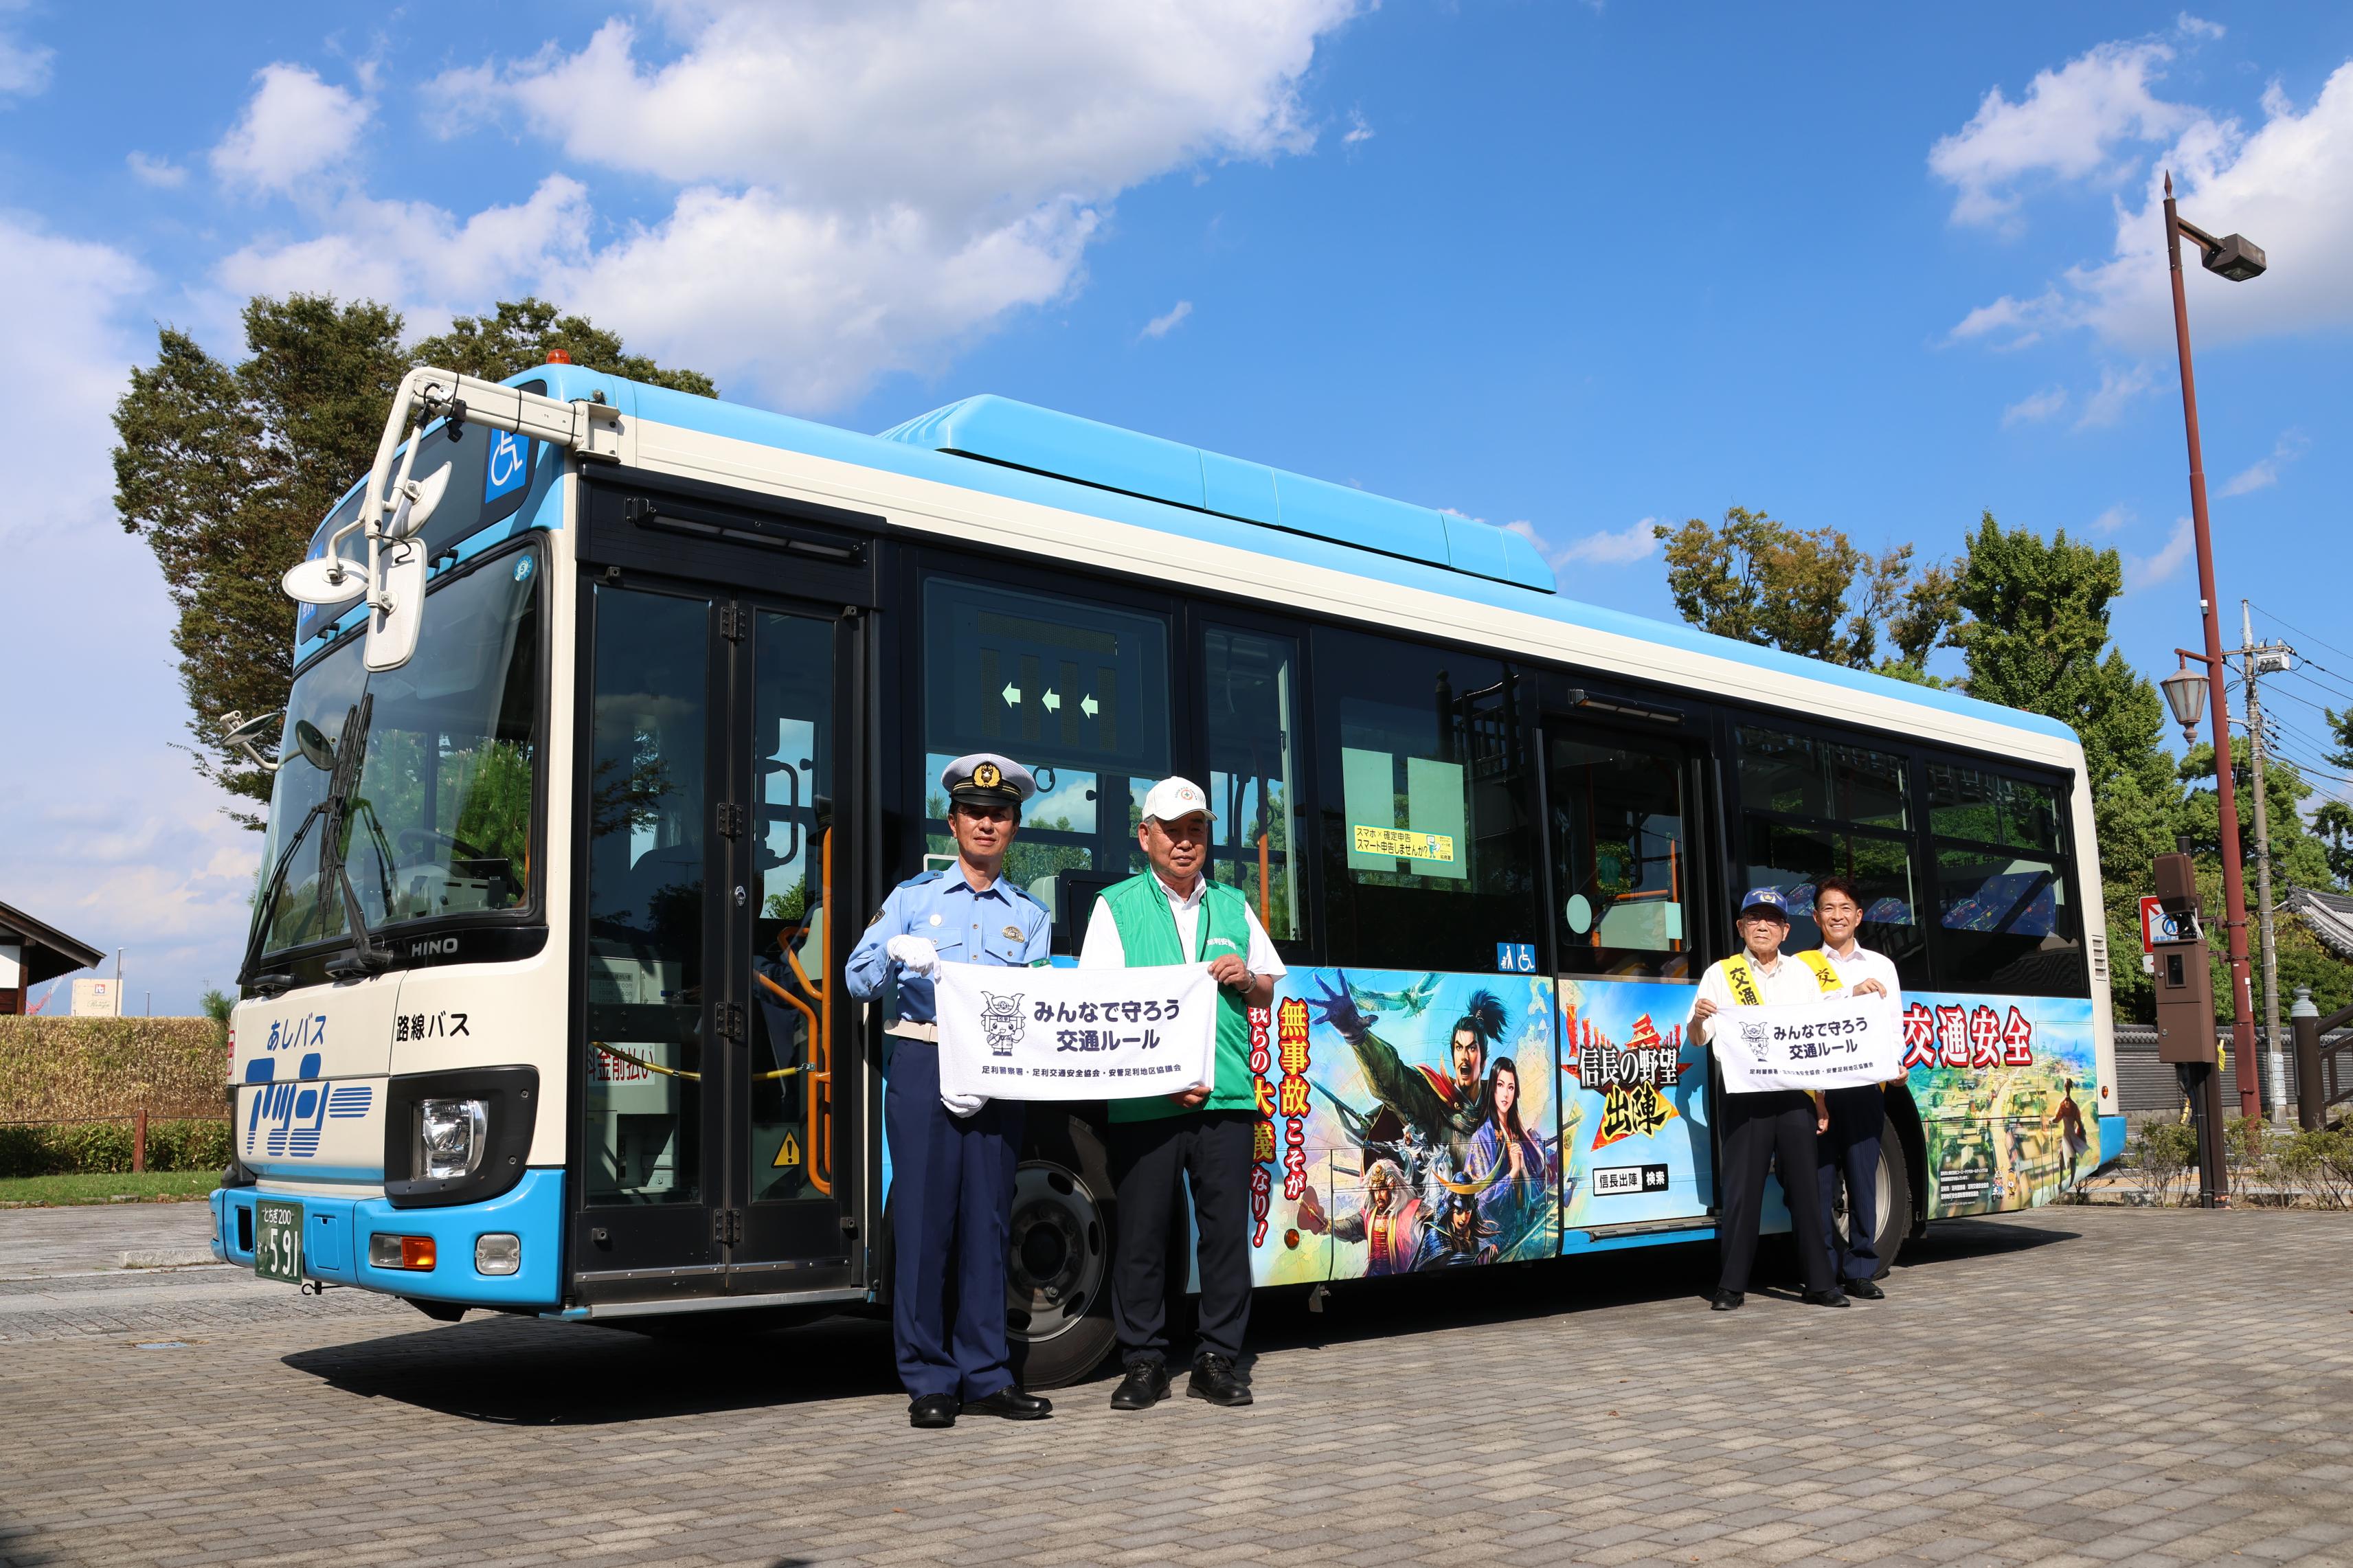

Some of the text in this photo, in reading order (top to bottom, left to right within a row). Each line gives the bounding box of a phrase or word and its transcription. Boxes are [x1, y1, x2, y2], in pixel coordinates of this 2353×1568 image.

[1358, 839, 1428, 857] スマート申告しませんか?
[412, 938, 458, 957] HINO
[1034, 999, 1180, 1023] みんなで守ろう
[267, 1011, 326, 1052] あしバス
[396, 1010, 470, 1042] 路線バス
[1773, 1017, 1868, 1041] みんなで守ろう
[1903, 1008, 2029, 1064] 交通安全
[1056, 1029, 1160, 1052] 交通ルール
[1789, 1038, 1858, 1060] 交通ルール
[1578, 1047, 1679, 1088] 信長の野望
[1279, 1000, 1309, 1197] 無事故こそが
[1603, 1084, 1669, 1138] 出陣
[1599, 1170, 1665, 1189] 信長出陣 検索
